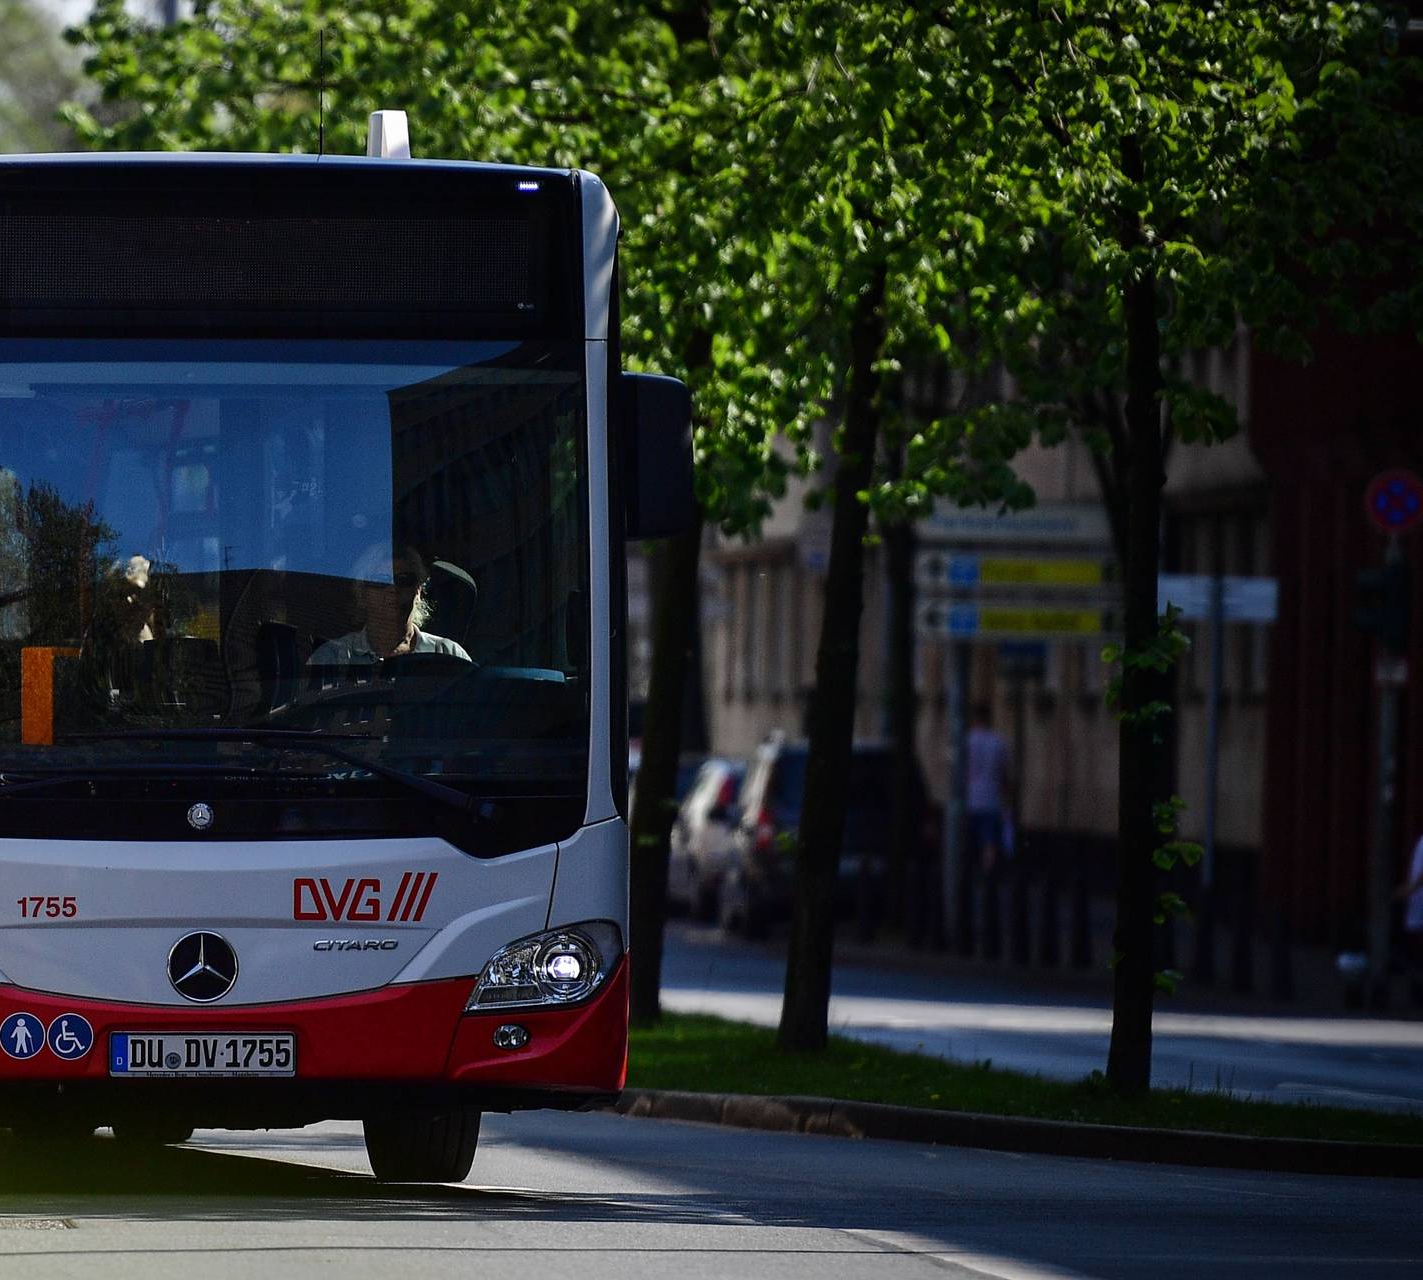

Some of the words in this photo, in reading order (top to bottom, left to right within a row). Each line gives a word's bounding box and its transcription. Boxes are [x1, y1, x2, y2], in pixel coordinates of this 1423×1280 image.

[17, 896, 77, 917] 1755
[294, 878, 380, 921] DVG
[313, 939, 398, 951] CITARO
[116, 1056, 123, 1066] D
[130, 1039, 164, 1068] DU
